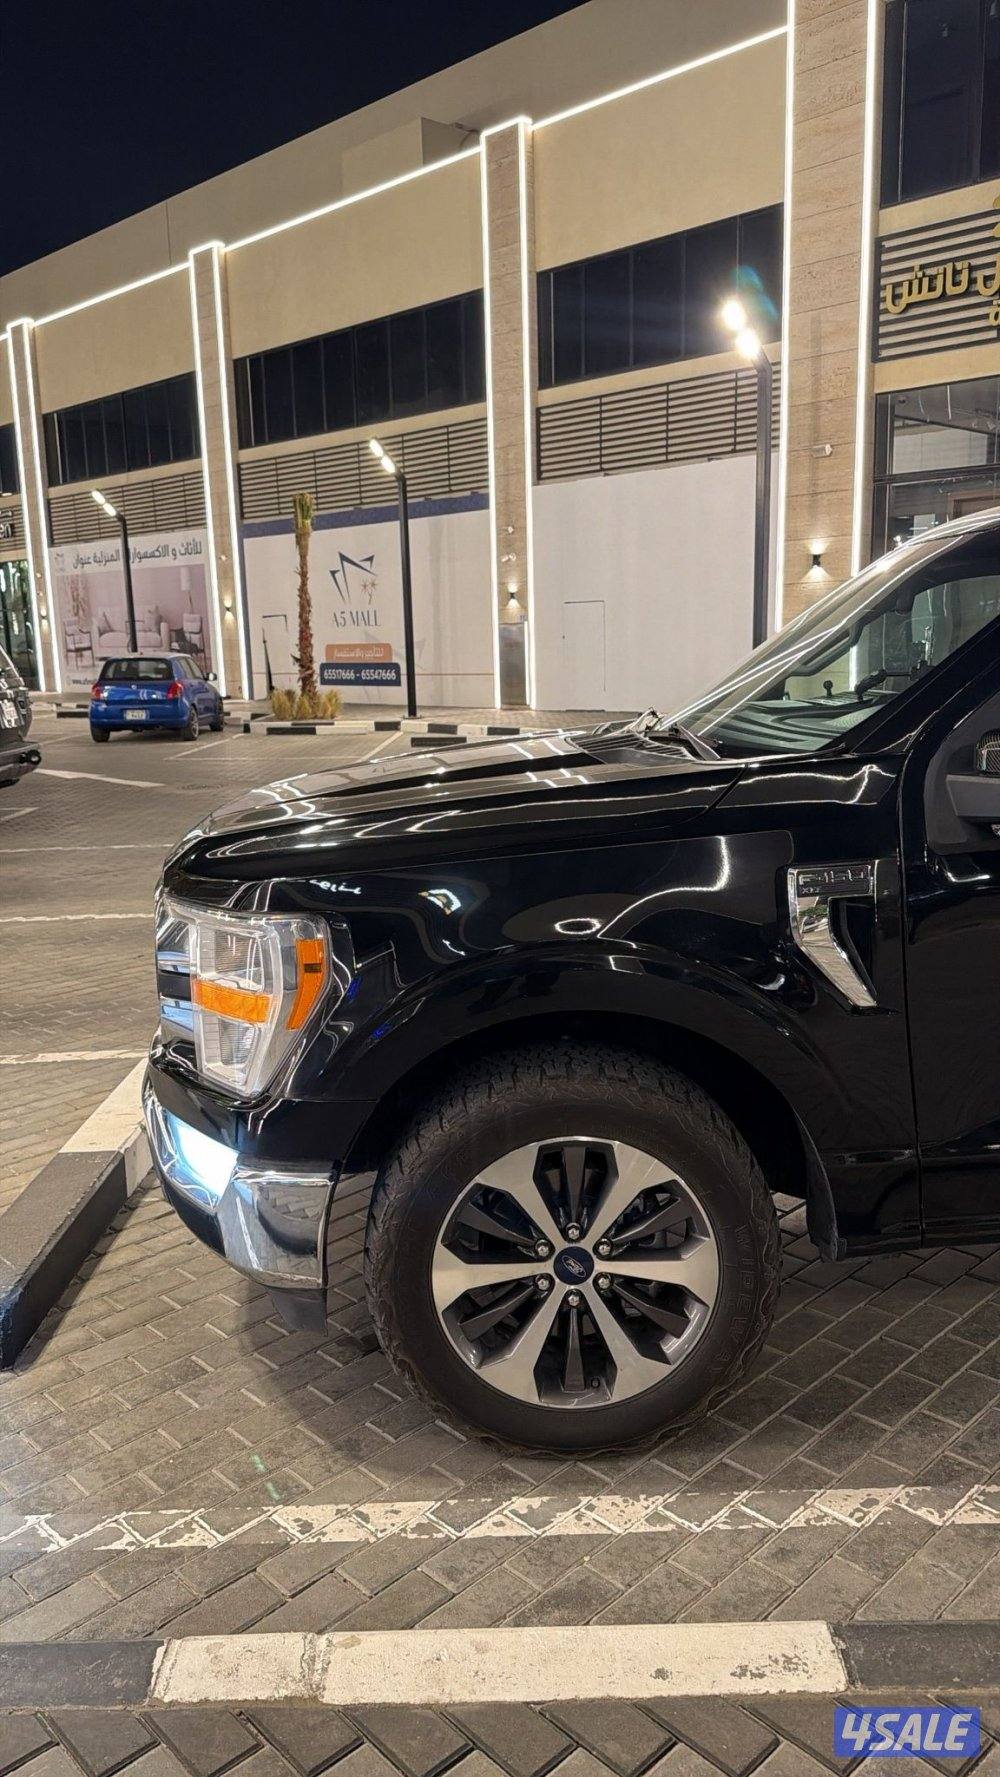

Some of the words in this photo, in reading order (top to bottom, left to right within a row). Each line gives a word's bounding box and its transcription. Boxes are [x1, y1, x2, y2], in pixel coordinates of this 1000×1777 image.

[885, 260, 970, 314] تاتش
[130, 544, 170, 563] الاكسسوار
[171, 547, 177, 560] و
[179, 538, 202, 556] للأثاث
[93, 549, 120, 566] المنزلية
[332, 610, 346, 628] A5
[349, 609, 381, 627] MALL
